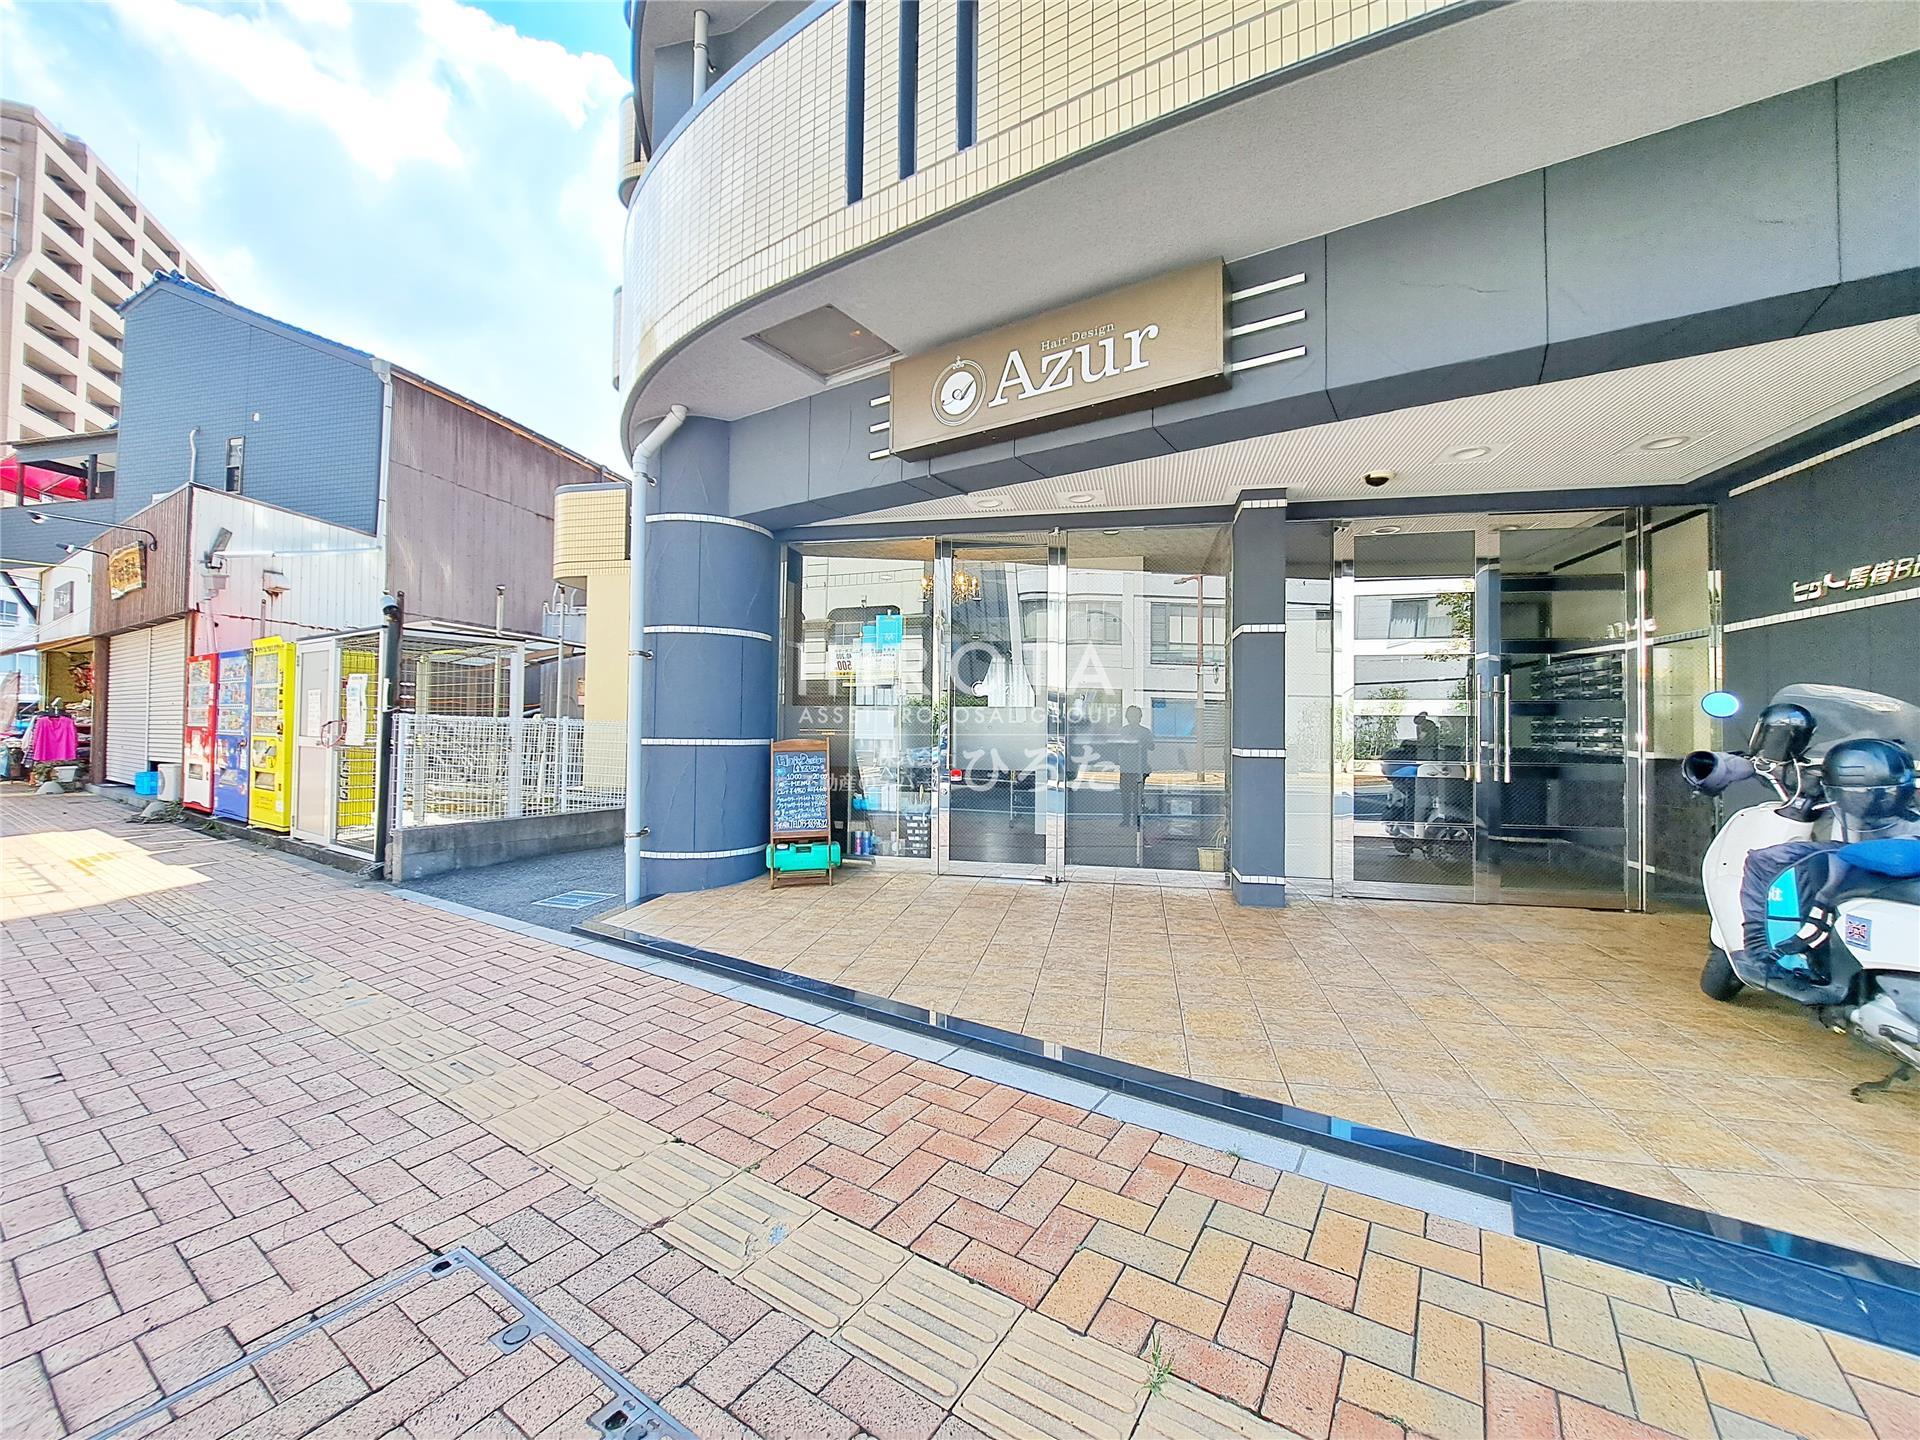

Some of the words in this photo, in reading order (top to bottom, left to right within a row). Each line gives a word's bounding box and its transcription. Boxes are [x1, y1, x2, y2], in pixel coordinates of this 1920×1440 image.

[1041, 336, 1068, 351] Hair
[1072, 323, 1114, 342] Design
[988, 324, 1159, 408] Azur
